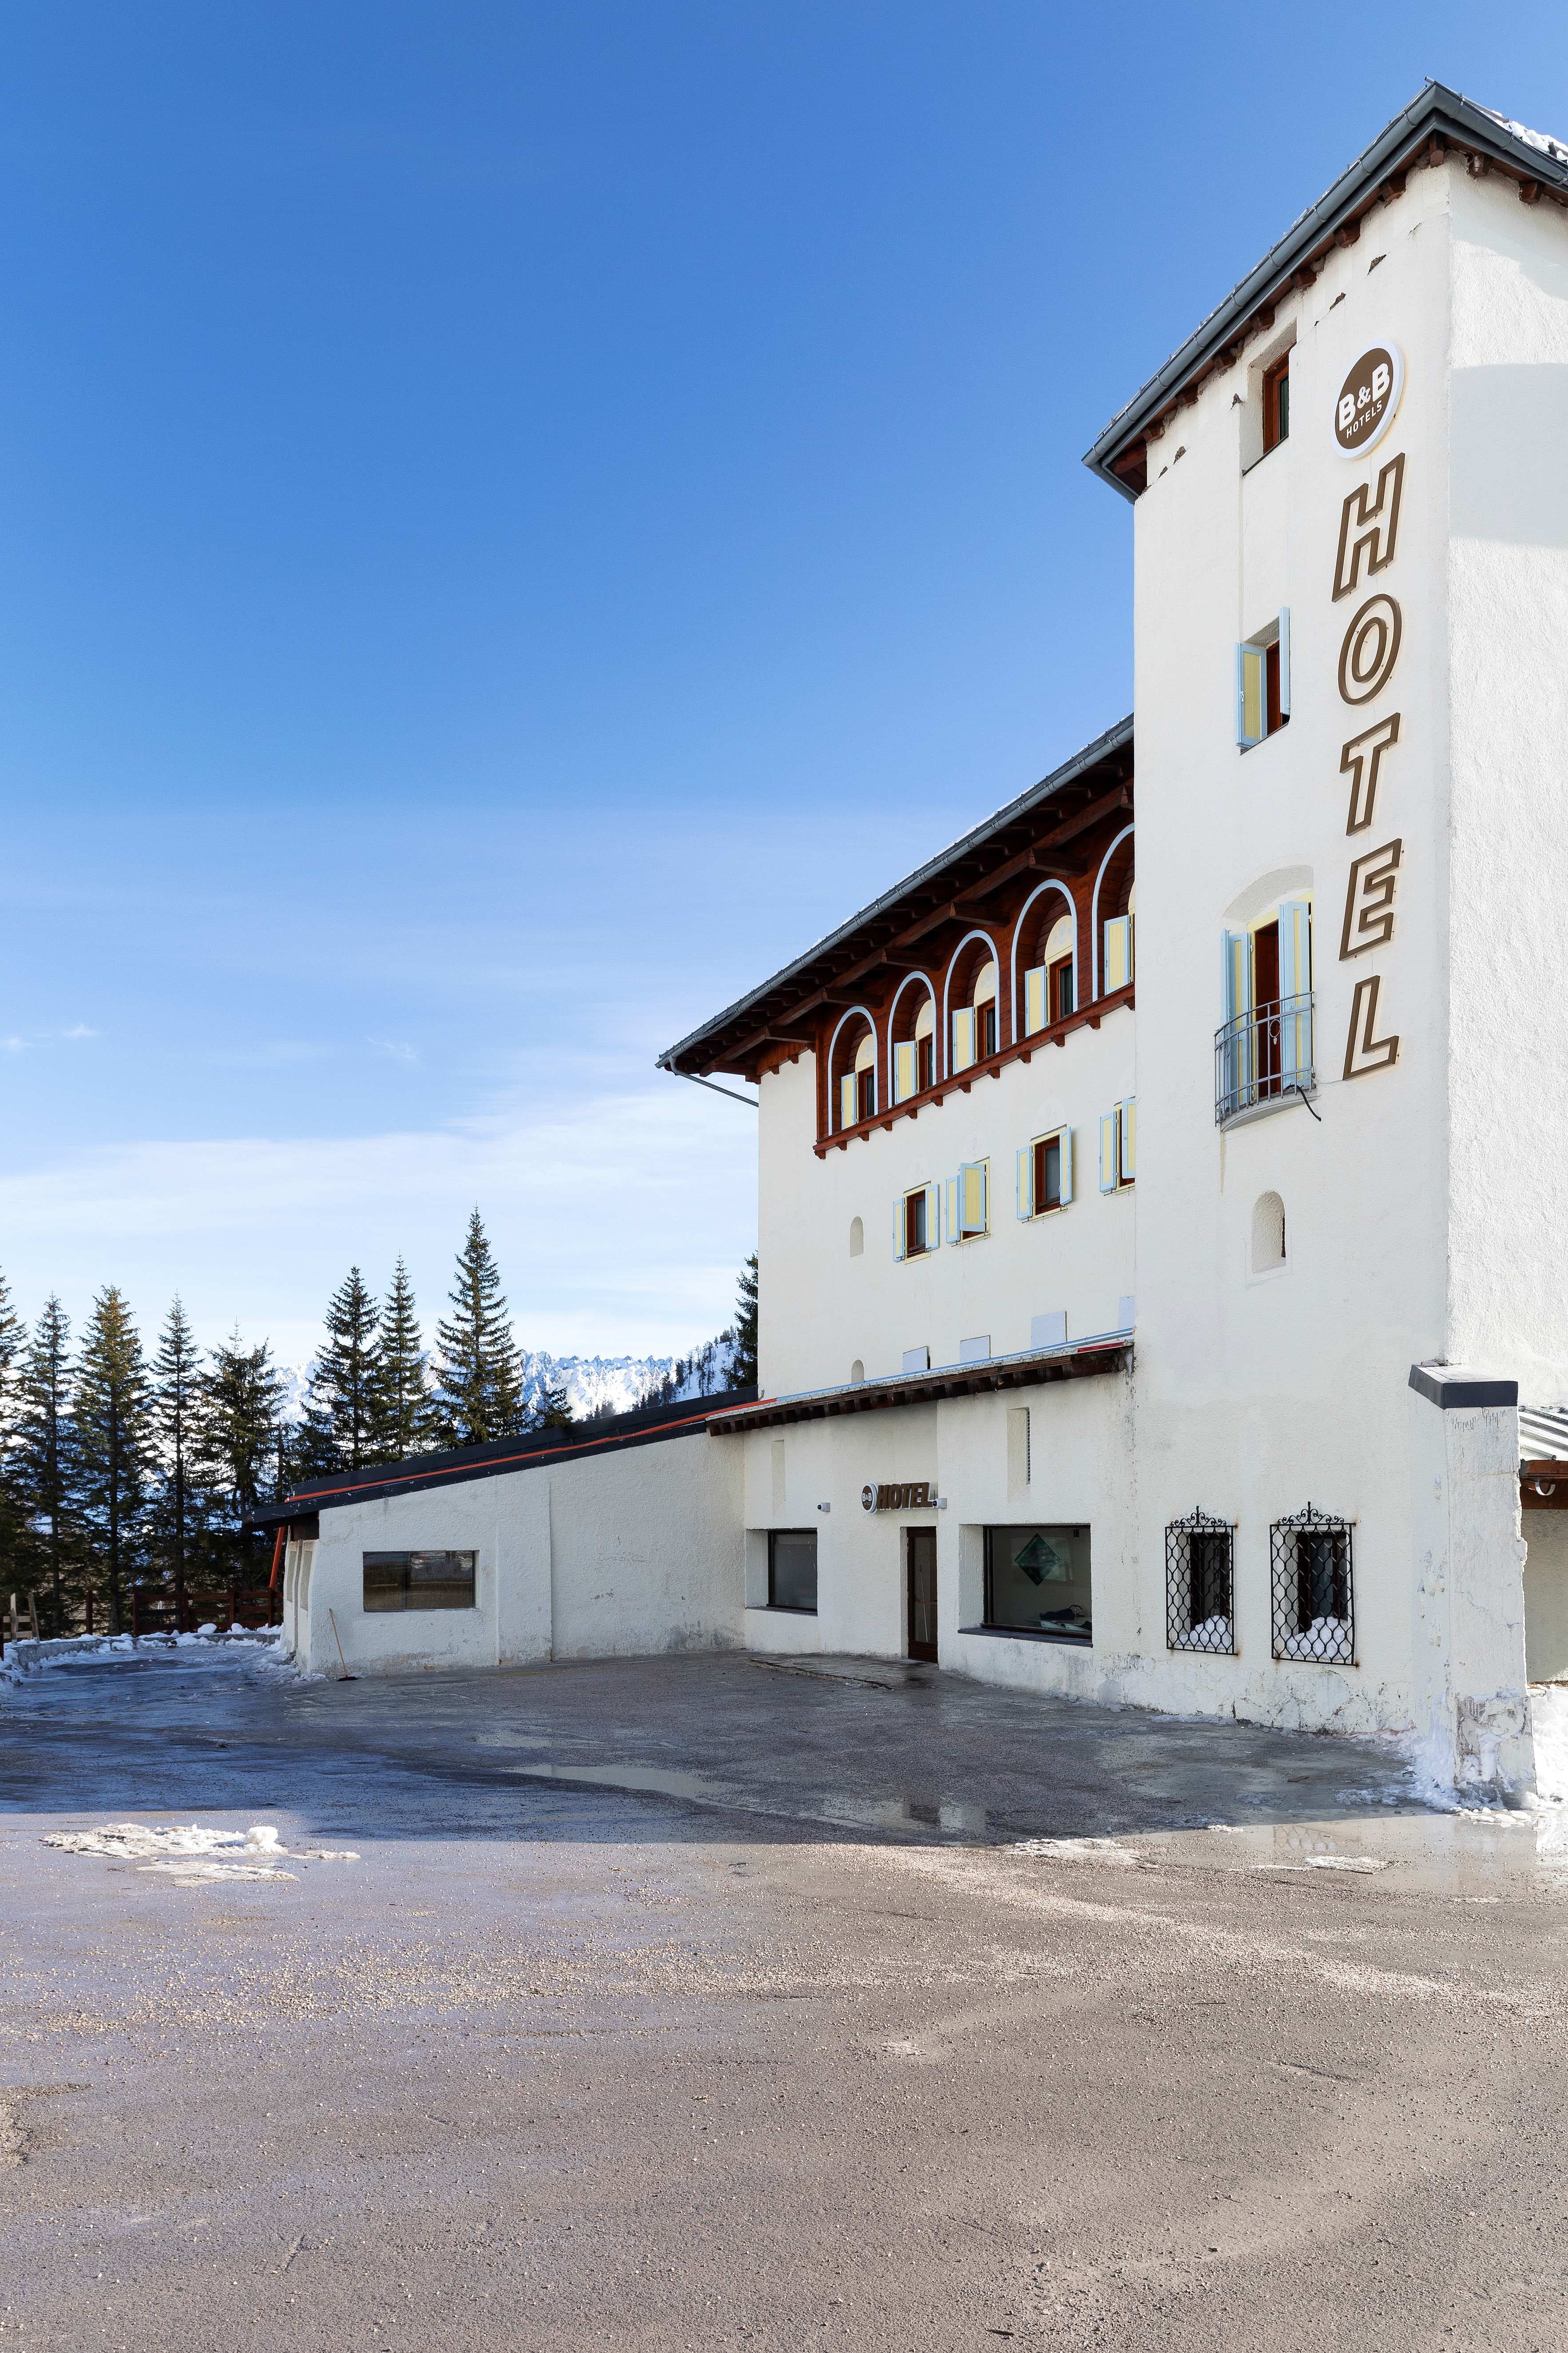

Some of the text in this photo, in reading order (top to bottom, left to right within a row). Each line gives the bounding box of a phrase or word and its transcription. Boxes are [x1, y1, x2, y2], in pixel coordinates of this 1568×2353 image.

[1339, 363, 1390, 431] B&B
[1346, 400, 1382, 439] HOTELS
[1331, 452, 1405, 1081] HOTEL
[877, 1482, 933, 1509] HOTEL
